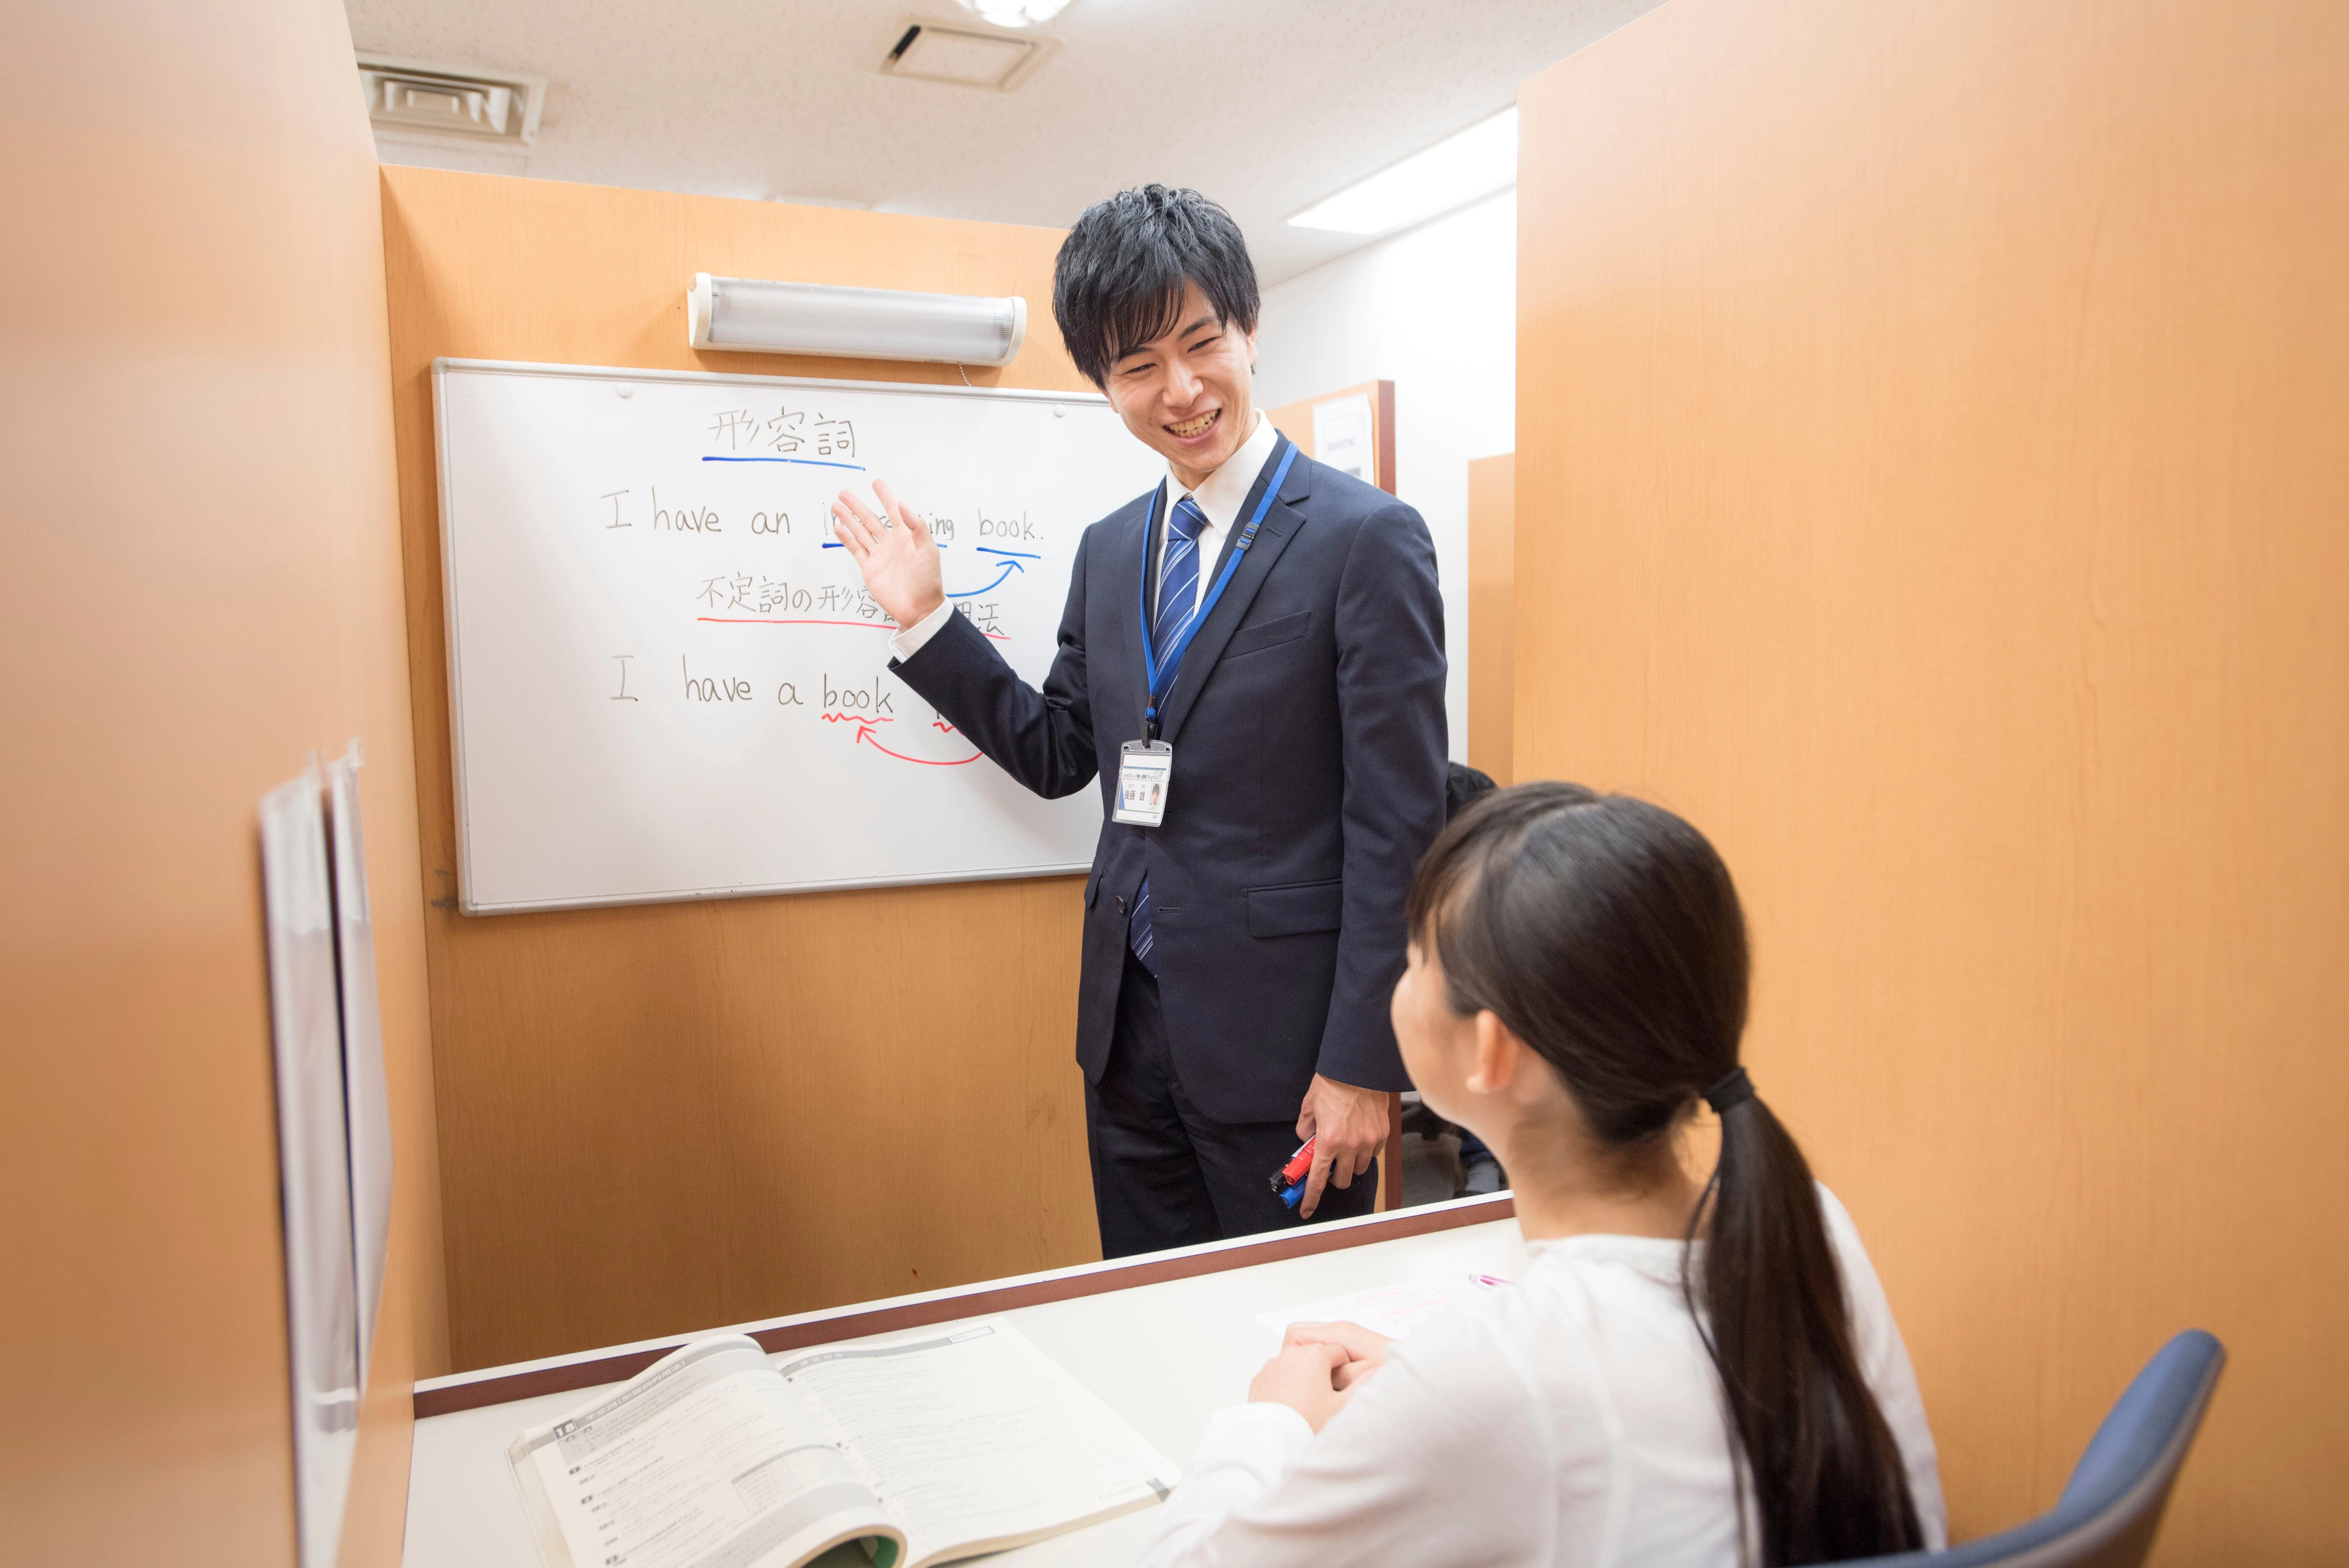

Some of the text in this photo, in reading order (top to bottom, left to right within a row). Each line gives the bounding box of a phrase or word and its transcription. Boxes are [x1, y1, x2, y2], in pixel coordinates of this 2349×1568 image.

[708, 406, 855, 459] 形容詞
[600, 489, 633, 529] I
[652, 485, 722, 534] have
[751, 511, 790, 535] an
[610, 653, 893, 714] I have a book
[555, 1422, 576, 1438] 18
